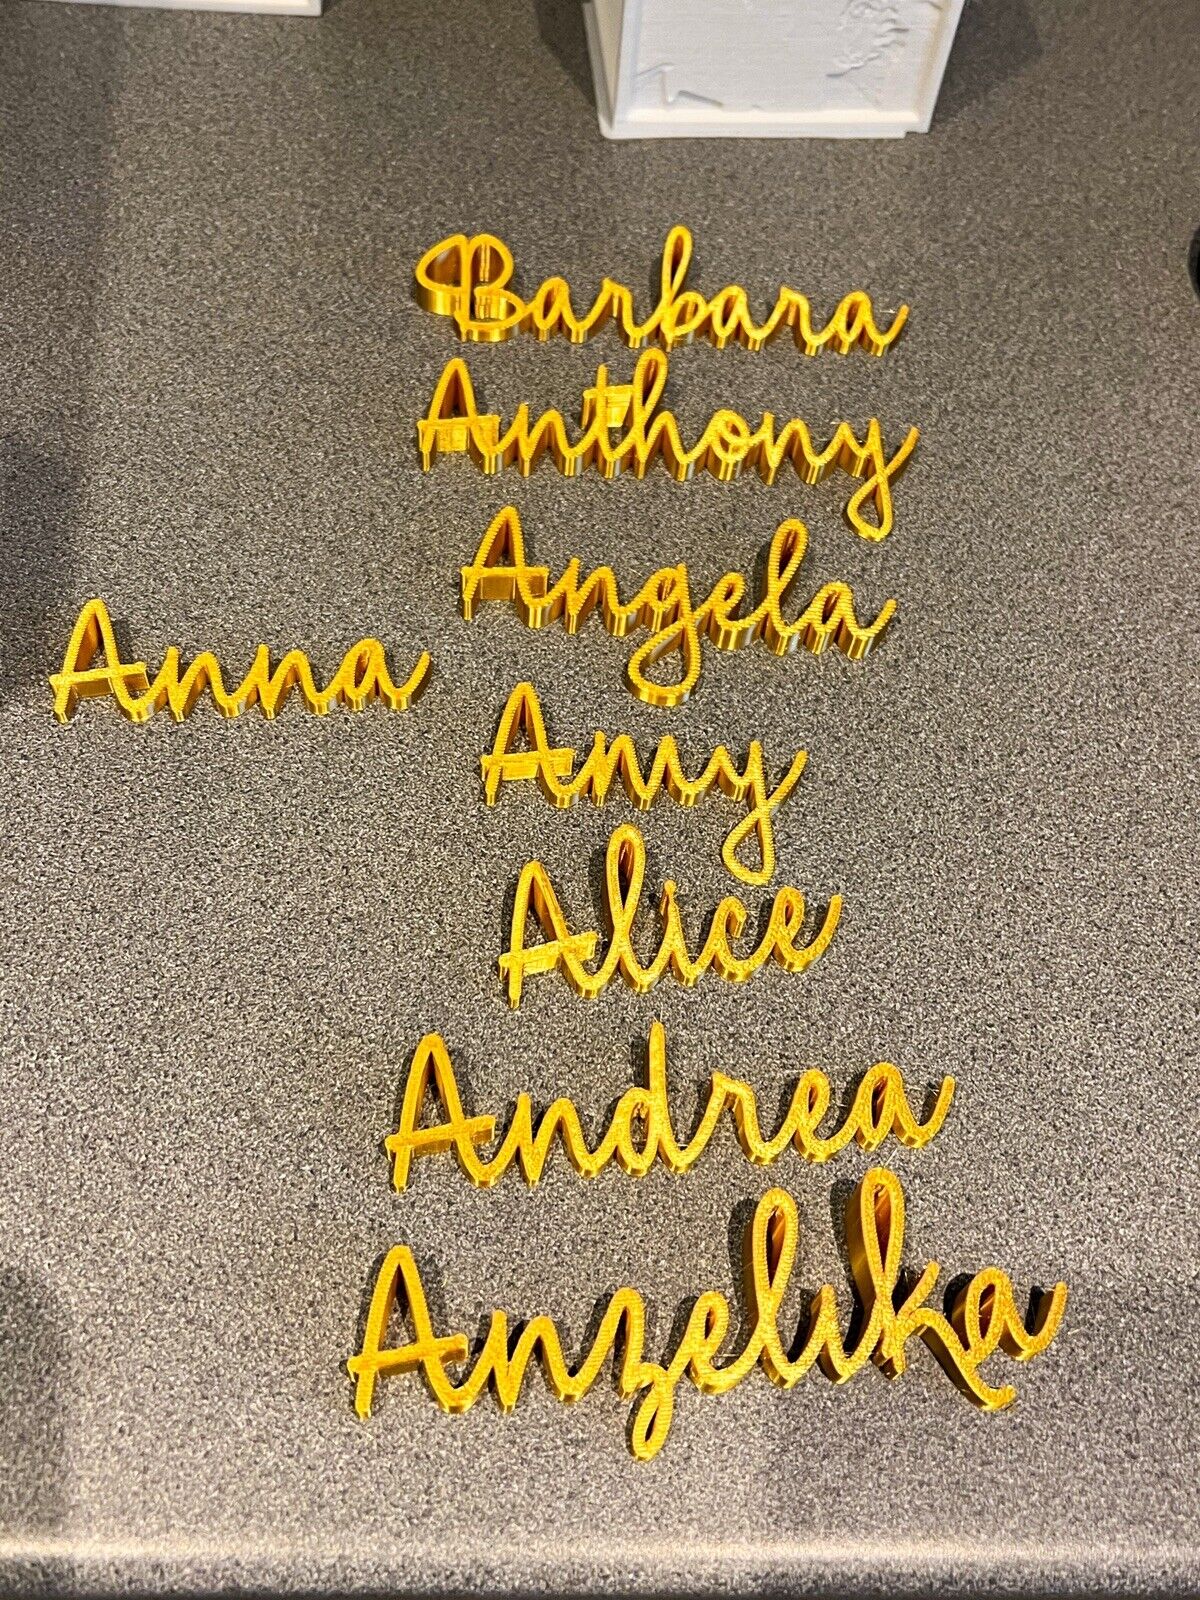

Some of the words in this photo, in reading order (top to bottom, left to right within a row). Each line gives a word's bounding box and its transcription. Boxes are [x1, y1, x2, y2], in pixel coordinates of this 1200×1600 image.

[415, 225, 910, 357] Barbara
[417, 347, 920, 542] Anthony
[50, 598, 432, 725] Anna
[460, 505, 898, 708] Angela
[480, 682, 808, 886] Amy
[498, 823, 844, 1009] Alice
[385, 1022, 956, 1194] Andrea
